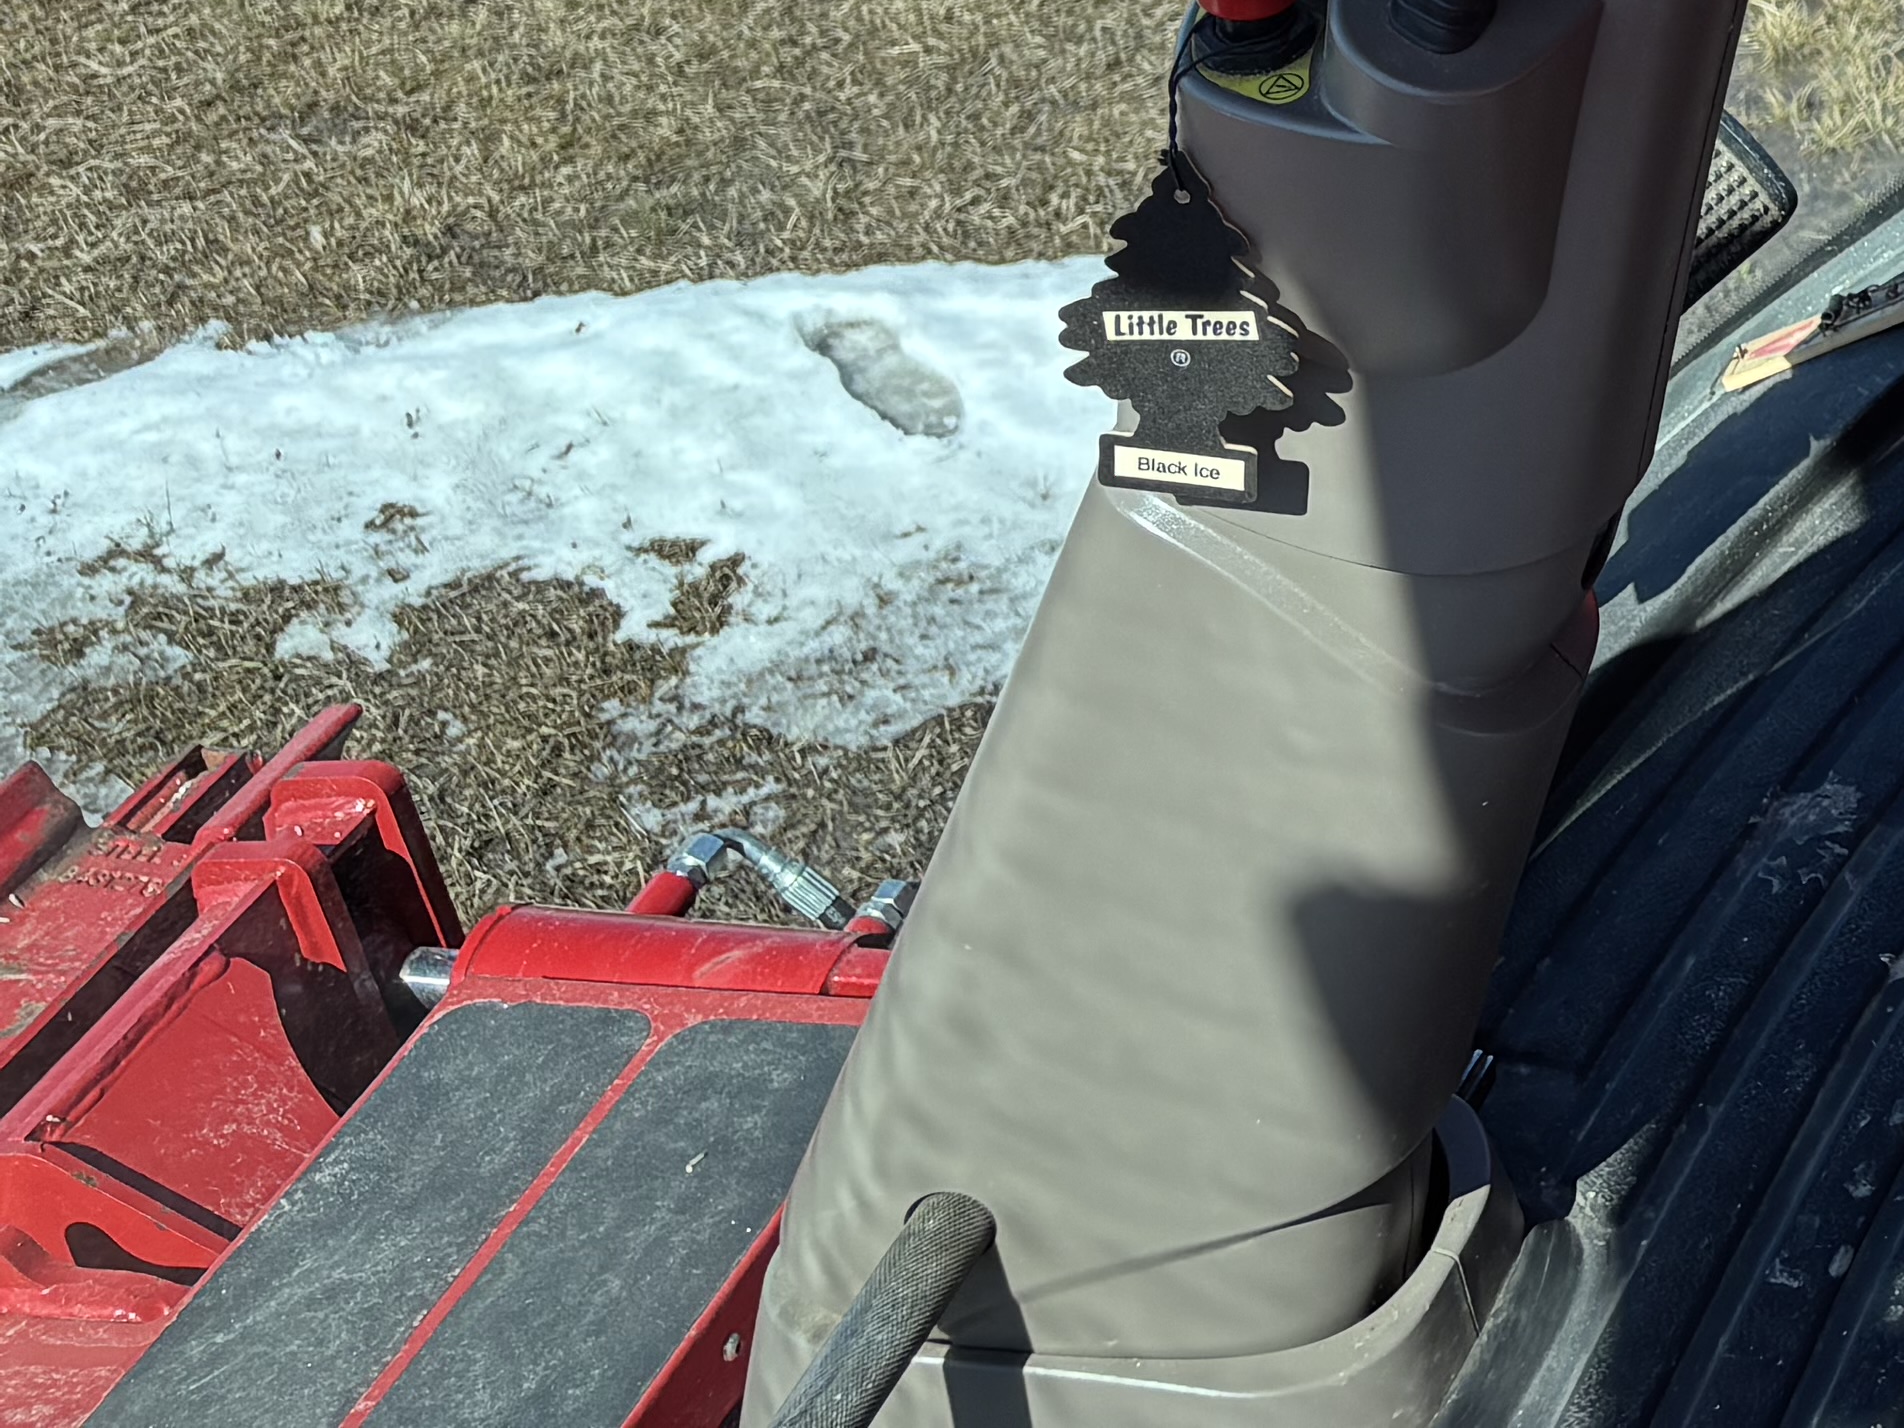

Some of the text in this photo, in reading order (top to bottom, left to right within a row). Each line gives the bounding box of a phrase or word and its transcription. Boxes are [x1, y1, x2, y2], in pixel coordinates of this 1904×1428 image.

[1113, 313, 1251, 337] Little Trees
[1137, 456, 1221, 481] Black Ice
